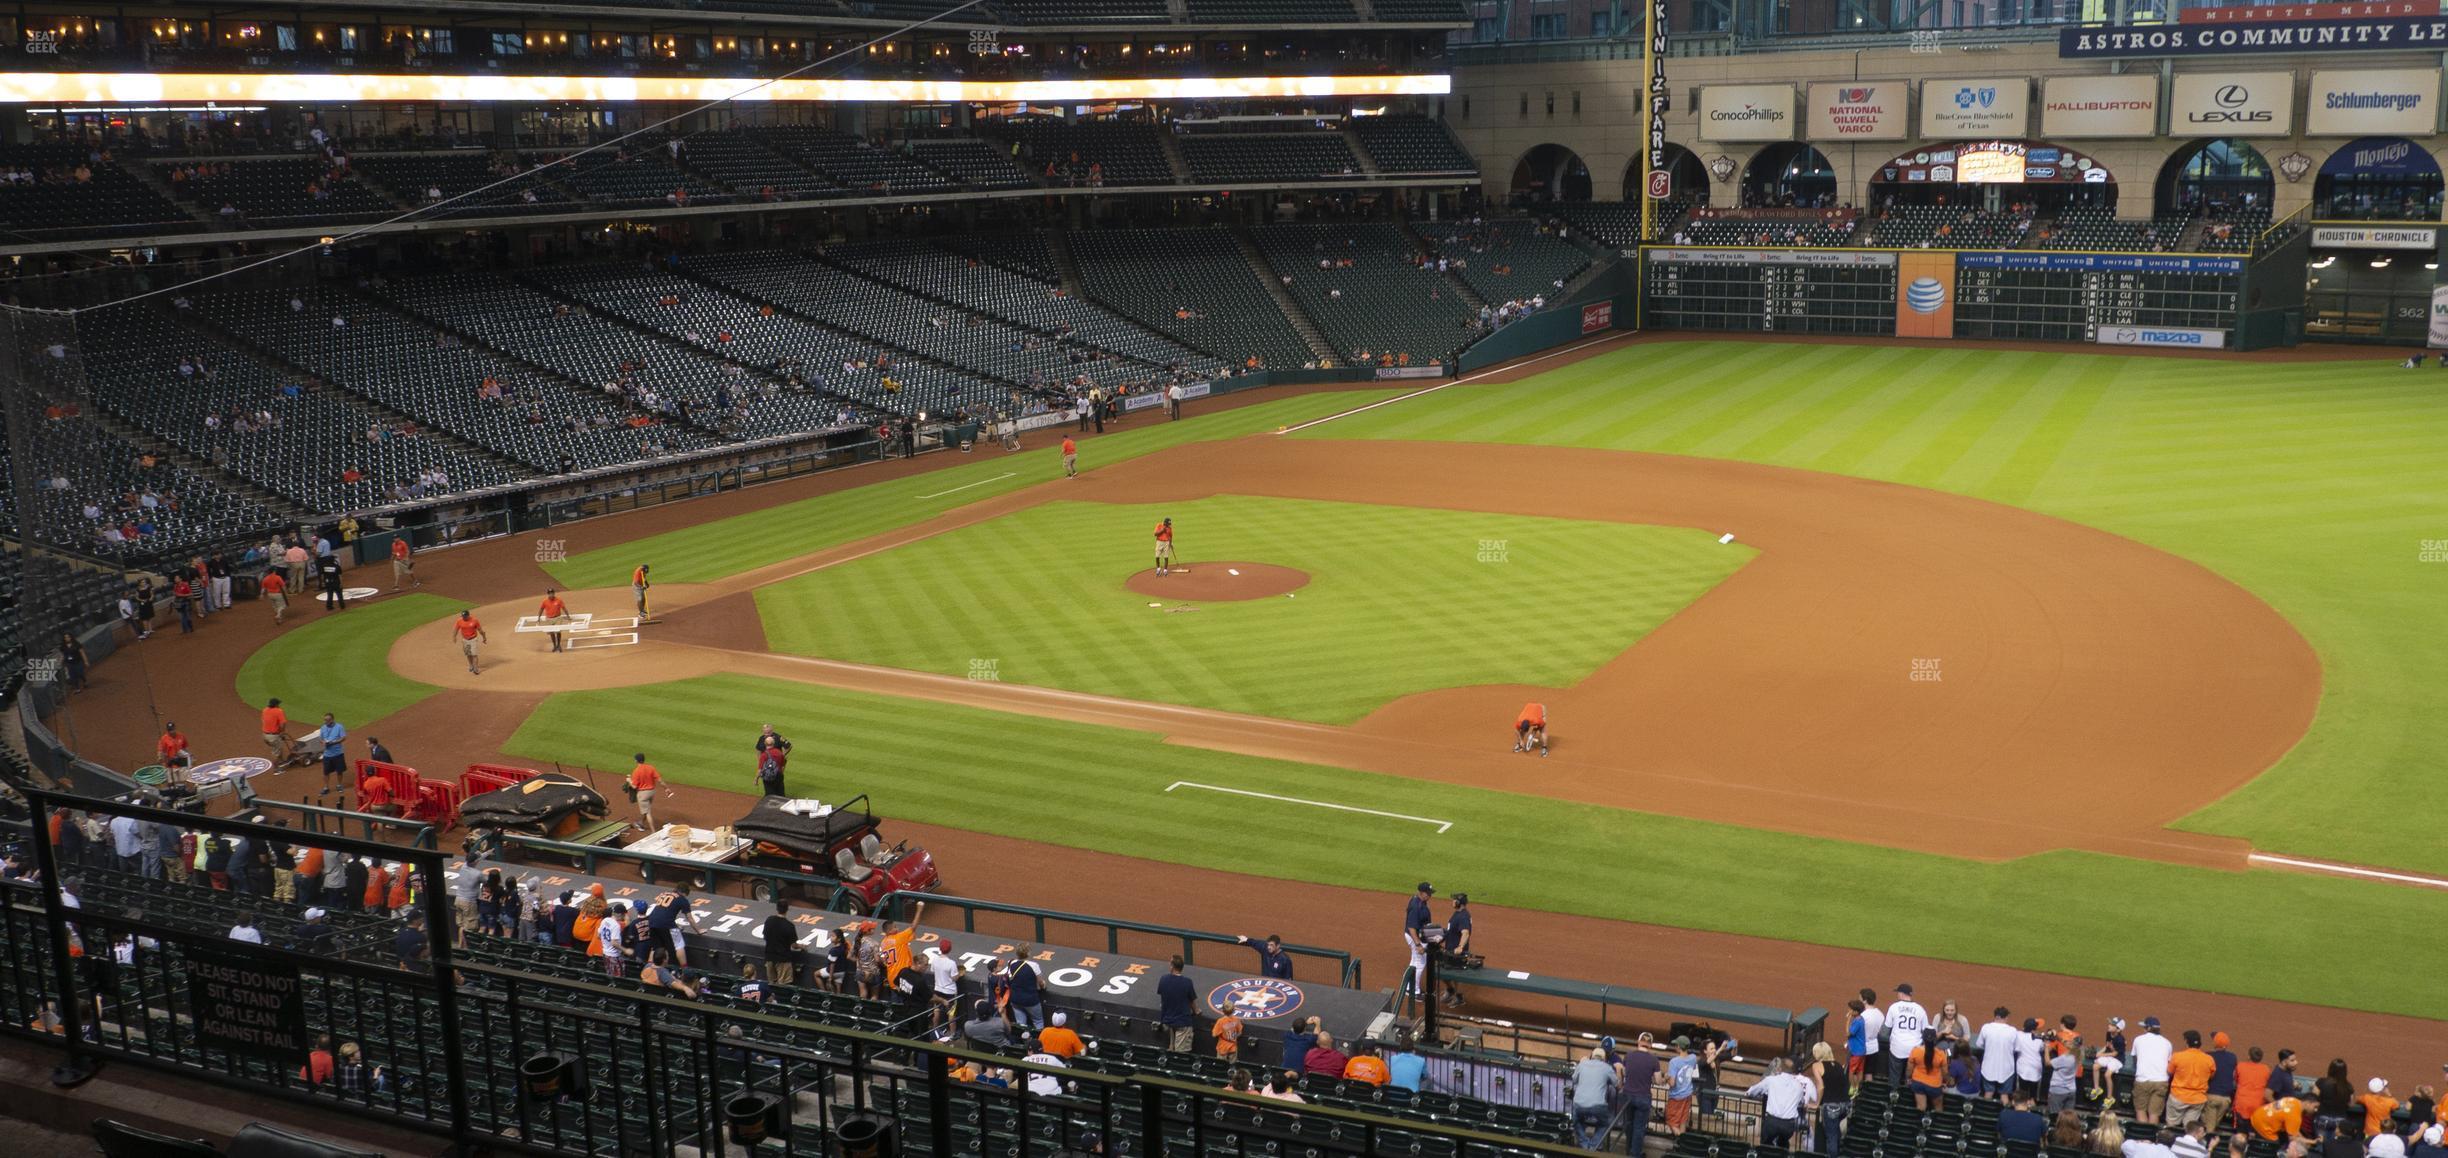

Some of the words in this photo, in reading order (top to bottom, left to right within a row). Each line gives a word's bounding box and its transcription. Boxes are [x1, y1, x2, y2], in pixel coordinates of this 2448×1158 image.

[2206, 7, 2313, 20] MINUTE
[2341, 4, 2412, 15] MAID
[2077, 31, 2184, 50] ASTROS
[2198, 24, 2394, 47] COMMUNITY
[2047, 101, 2152, 111] HALLIBURTON
[2326, 92, 2421, 112] Schlumberger
[1710, 109, 1784, 123] ConocoPhillips
[1828, 106, 1884, 115] NATIONAL
[1935, 112, 1972, 120] BlueCross
[1973, 112, 2013, 120] BlueShield
[2189, 111, 2272, 122] LEXUS
[1833, 115, 1878, 124] OILWELL
[1958, 121, 1967, 129] of
[1967, 121, 1989, 129] Texas
[1838, 125, 1874, 133] VARCO
[2318, 231, 2365, 241] HOUSTON
[2374, 232, 2430, 242] CHRONICLE
[1620, 249, 1638, 258] 315
[1765, 269, 1774, 328] NATIONAL
[2087, 275, 2098, 338] AMERICAN
[2399, 307, 2425, 318] 362
[2141, 330, 2202, 344] mazda
[1381, 368, 1400, 376] BDO
[993, 943, 1151, 975] PARK
[187, 960, 239, 983] PLEASE
[241, 971, 262, 988] DO
[266, 975, 297, 993] NOT
[1231, 979, 1299, 997] HOUSTON
[232, 988, 281, 1009] STAND
[215, 1003, 235, 1020] OR
[238, 1008, 277, 1027] LEAN
[1898, 1015, 1917, 1031] 20
[203, 1019, 260, 1043] AGAINST
[264, 1031, 299, 1050] RAIL
